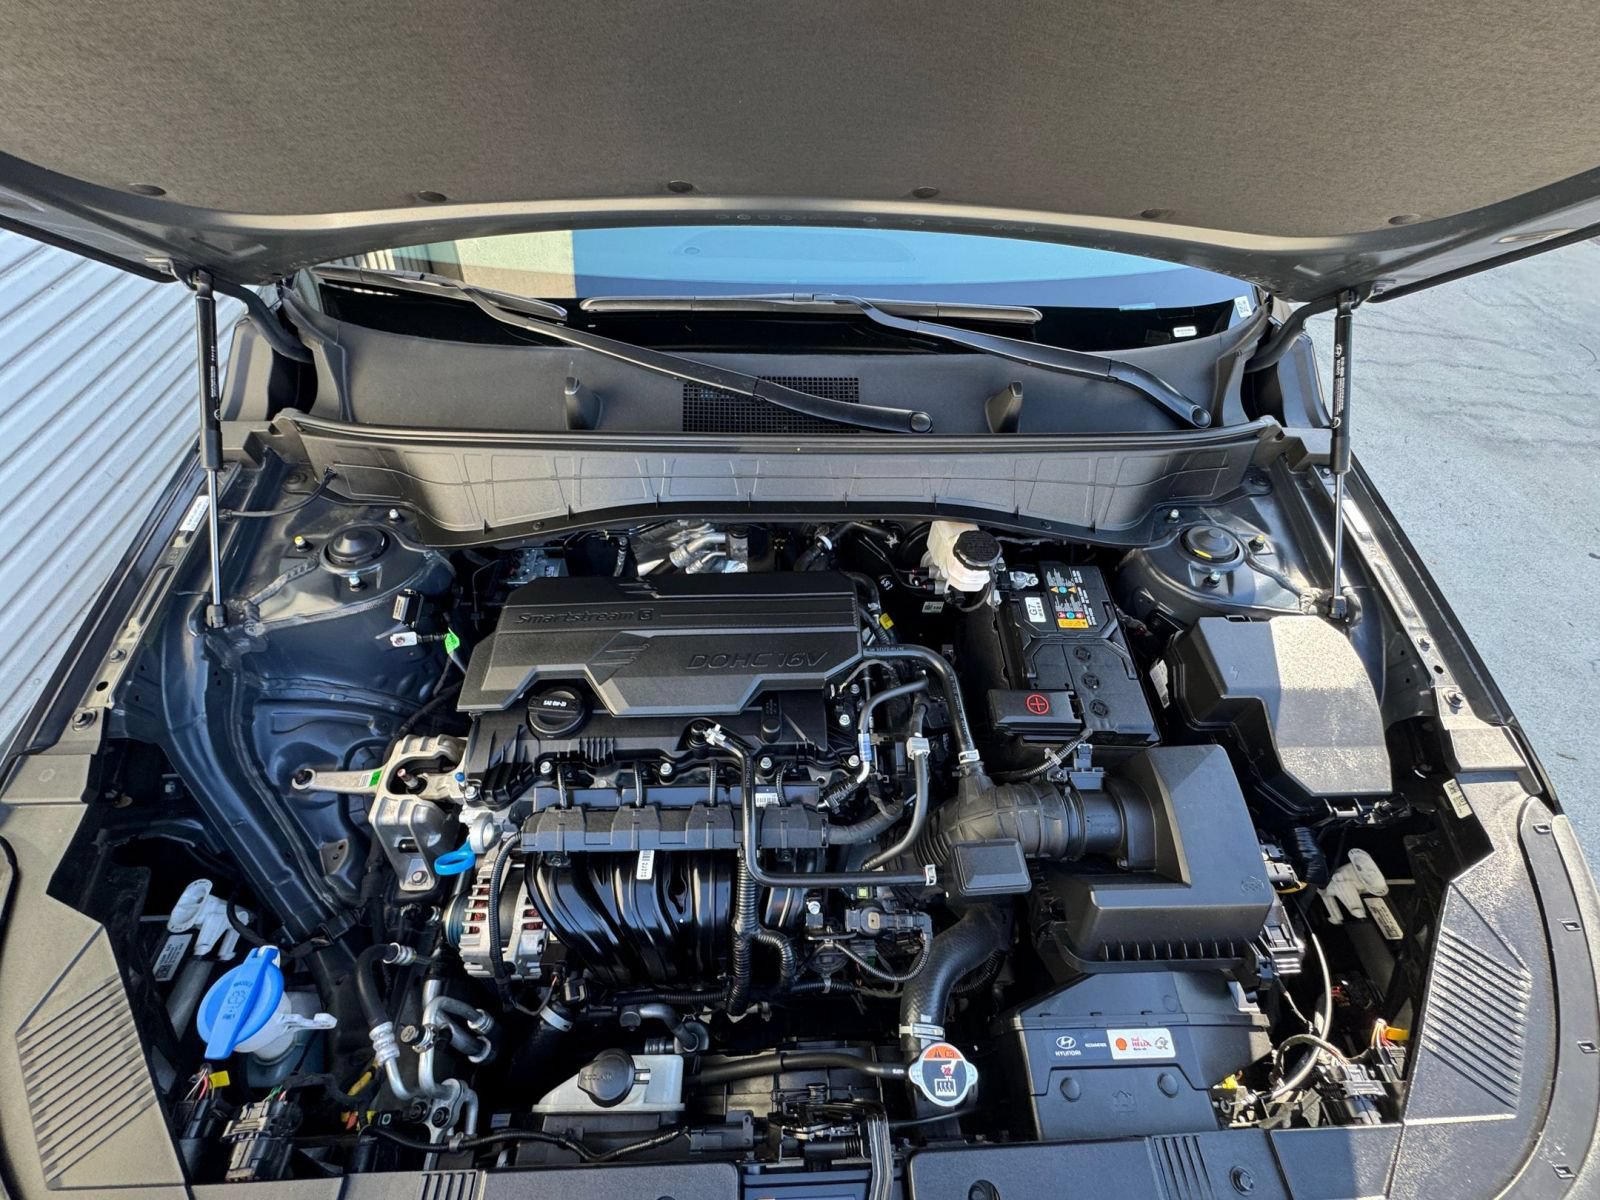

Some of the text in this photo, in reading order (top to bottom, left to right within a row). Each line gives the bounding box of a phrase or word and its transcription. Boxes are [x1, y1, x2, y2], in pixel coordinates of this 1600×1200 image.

[514, 610, 635, 624] Smartstream
[685, 651, 829, 670] DOHC 16V
[1055, 1049, 1082, 1057] HYUNDAI
